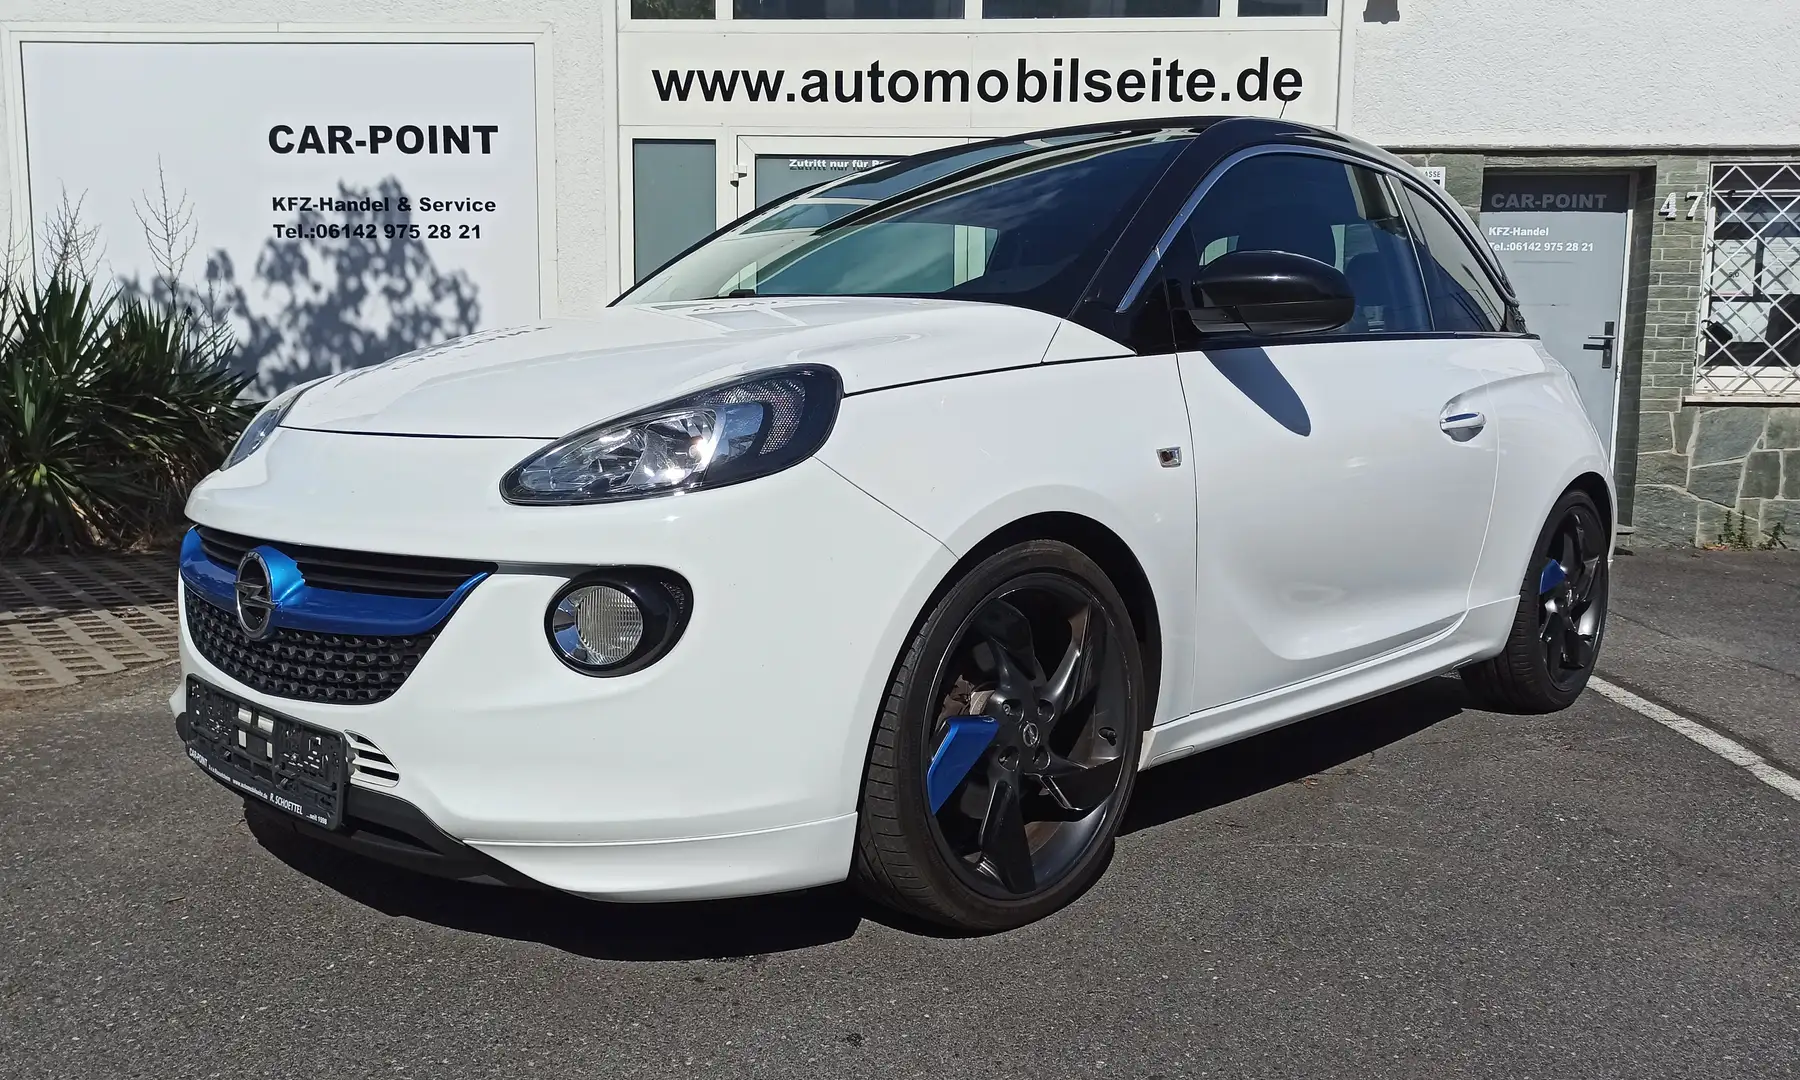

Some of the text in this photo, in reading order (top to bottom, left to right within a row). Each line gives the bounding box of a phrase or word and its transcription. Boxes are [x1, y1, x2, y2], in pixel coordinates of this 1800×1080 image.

[651, 57, 1303, 103] www.automobilseite.de
[268, 125, 499, 154] CAR-POINT
[789, 159, 826, 167] Zutritt
[852, 159, 869, 168] für
[272, 197, 497, 212] KFZ-Handel & Service
[1491, 194, 1608, 209] CAR-POINT
[273, 224, 482, 239] Tel.:06142 975 28 21
[1488, 227, 1549, 236] KFZ-Handel
[1544, 242, 1563, 252] 975
[1565, 242, 1579, 252] 28
[1581, 242, 1594, 252] 21
[275, 796, 303, 815] SCHOETTEL
